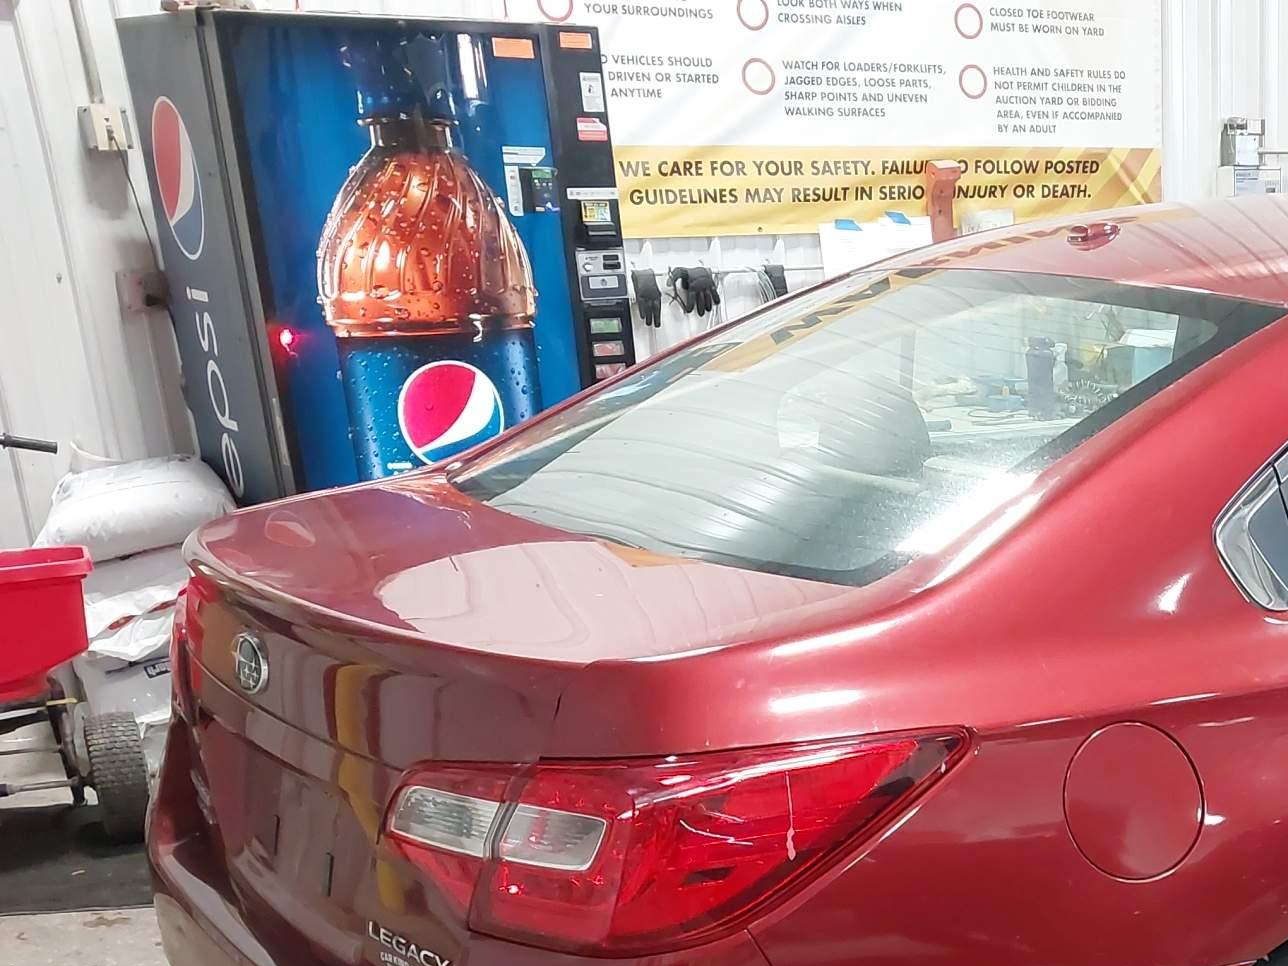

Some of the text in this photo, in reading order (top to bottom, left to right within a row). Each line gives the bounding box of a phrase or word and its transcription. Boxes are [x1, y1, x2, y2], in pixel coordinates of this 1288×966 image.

[584, 3, 713, 19] YOUR SURROUNDINGS
[809, 0, 837, 9] BOTH
[842, 0, 869, 10] WAYS
[873, 1, 902, 12] WHEN
[777, 13, 866, 25] CROSSING AISLES
[989, 7, 1095, 22] CLOSED TOE FOOTWEAR
[990, 22, 1105, 37] MUST BE WORN ON YARD
[611, 54, 664, 66] VEHICLES
[668, 56, 712, 67] SHOULD
[782, 60, 947, 75] WATCH FOR LOADERS/FORKLIFTS,
[993, 66, 1126, 80] HEALTH AND SAFETY RULES DO
[608, 71, 719, 84] DRIVEN OR STARTED
[784, 76, 932, 89] JAGGED EDGES, LOOSE PARTS,
[610, 88, 662, 98] ANYTIME
[994, 81, 1122, 94] NOT PERMIT CHILDREN IN THE
[784, 91, 928, 103] SHARP POINTS AND UNEVEN
[995, 95, 1117, 107] AUCTION YARD OR BIDDING
[784, 106, 886, 117] WALKING SURFACES
[996, 110, 1122, 121] AREA, EVEN IF ACCOMPANIED
[997, 124, 1056, 133] BY AN ADULT
[619, 161, 651, 177] WE
[658, 161, 703, 177] CARE
[711, 161, 748, 177] FOR
[753, 160, 804, 176] YOUR
[811, 160, 876, 176] SAFETY.
[881, 160, 928, 175] FAILU
[974, 160, 1040, 174] FOLLOW
[1044, 160, 1099, 174] POSTED
[629, 188, 738, 205] GUIDELINES
[745, 187, 785, 204] MAY
[792, 186, 850, 203] RESULT
[855, 186, 873, 201] IN
[879, 185, 925, 200] SERIO
[1013, 184, 1035, 198] OR
[1041, 184, 1092, 199] DEATH.
[186, 286, 244, 498] epsi
